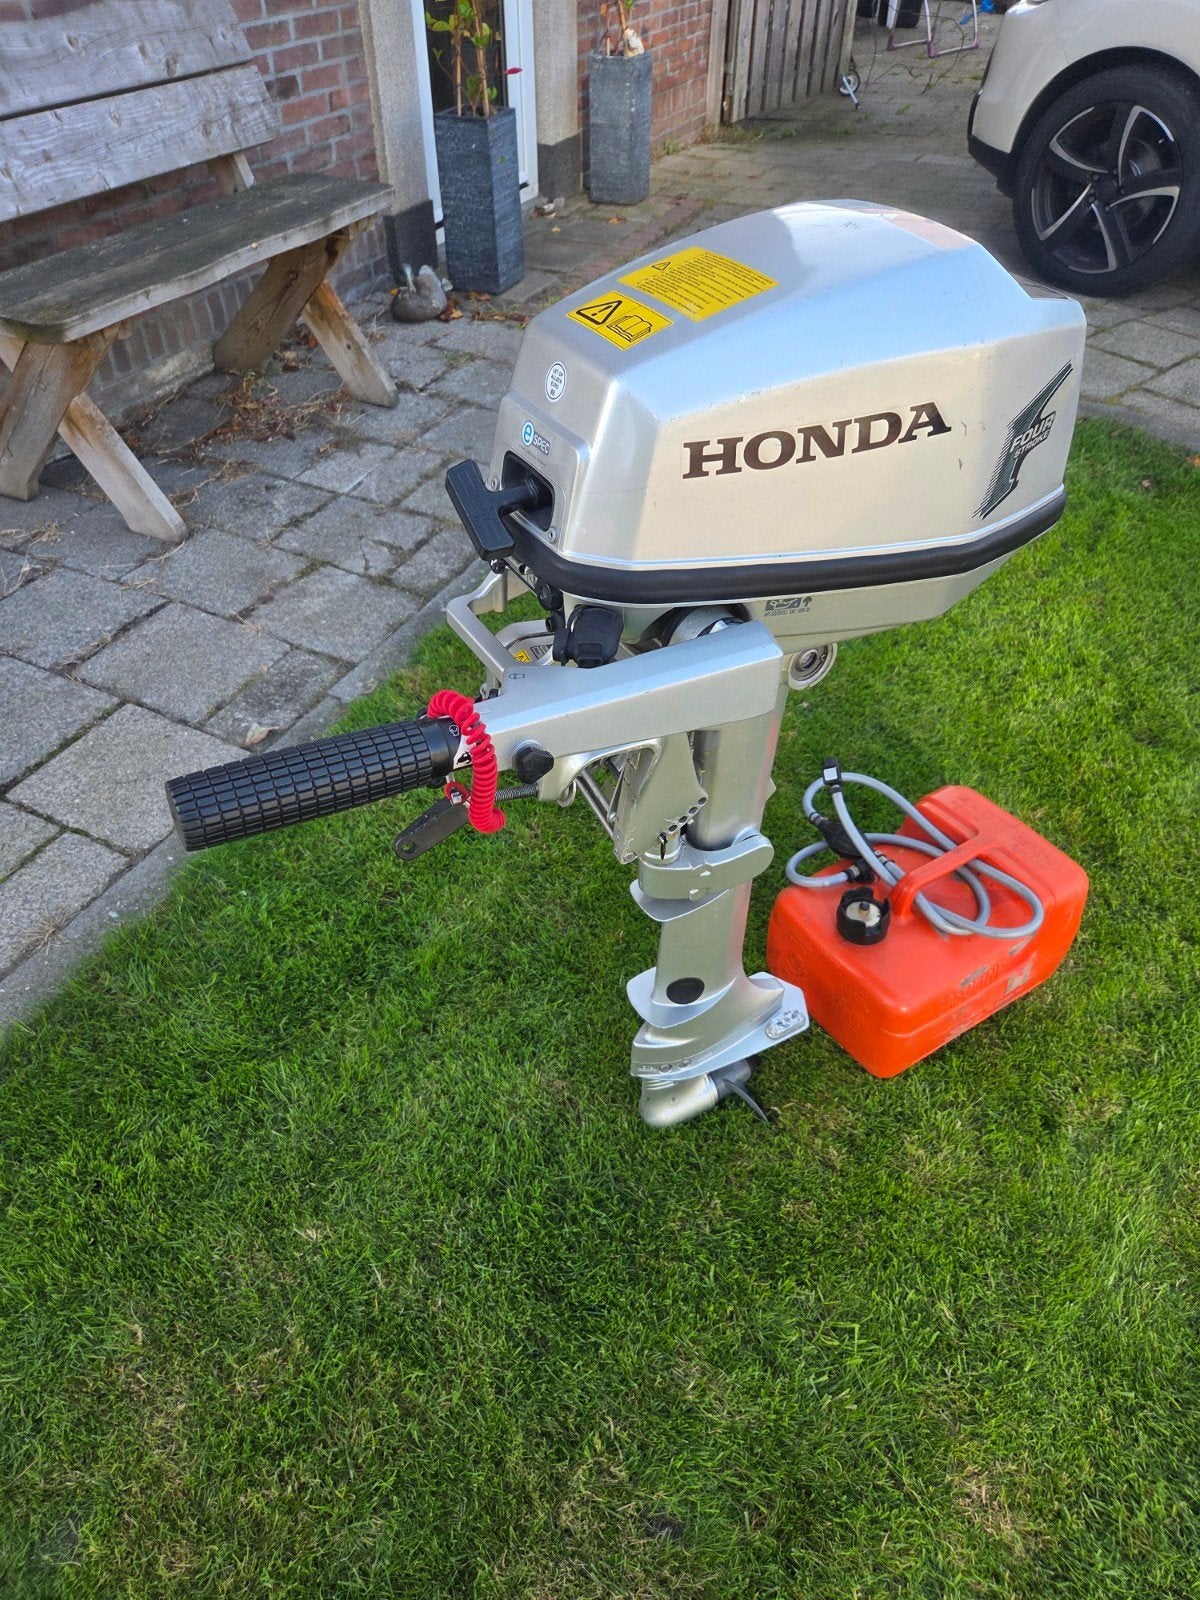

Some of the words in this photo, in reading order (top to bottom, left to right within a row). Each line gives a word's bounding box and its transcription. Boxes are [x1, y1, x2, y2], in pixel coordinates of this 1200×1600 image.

[533, 434, 550, 454] SPEC
[682, 401, 952, 480] HONDA
[1009, 414, 1055, 454] FOUR
[1014, 430, 1050, 459] STROKE
